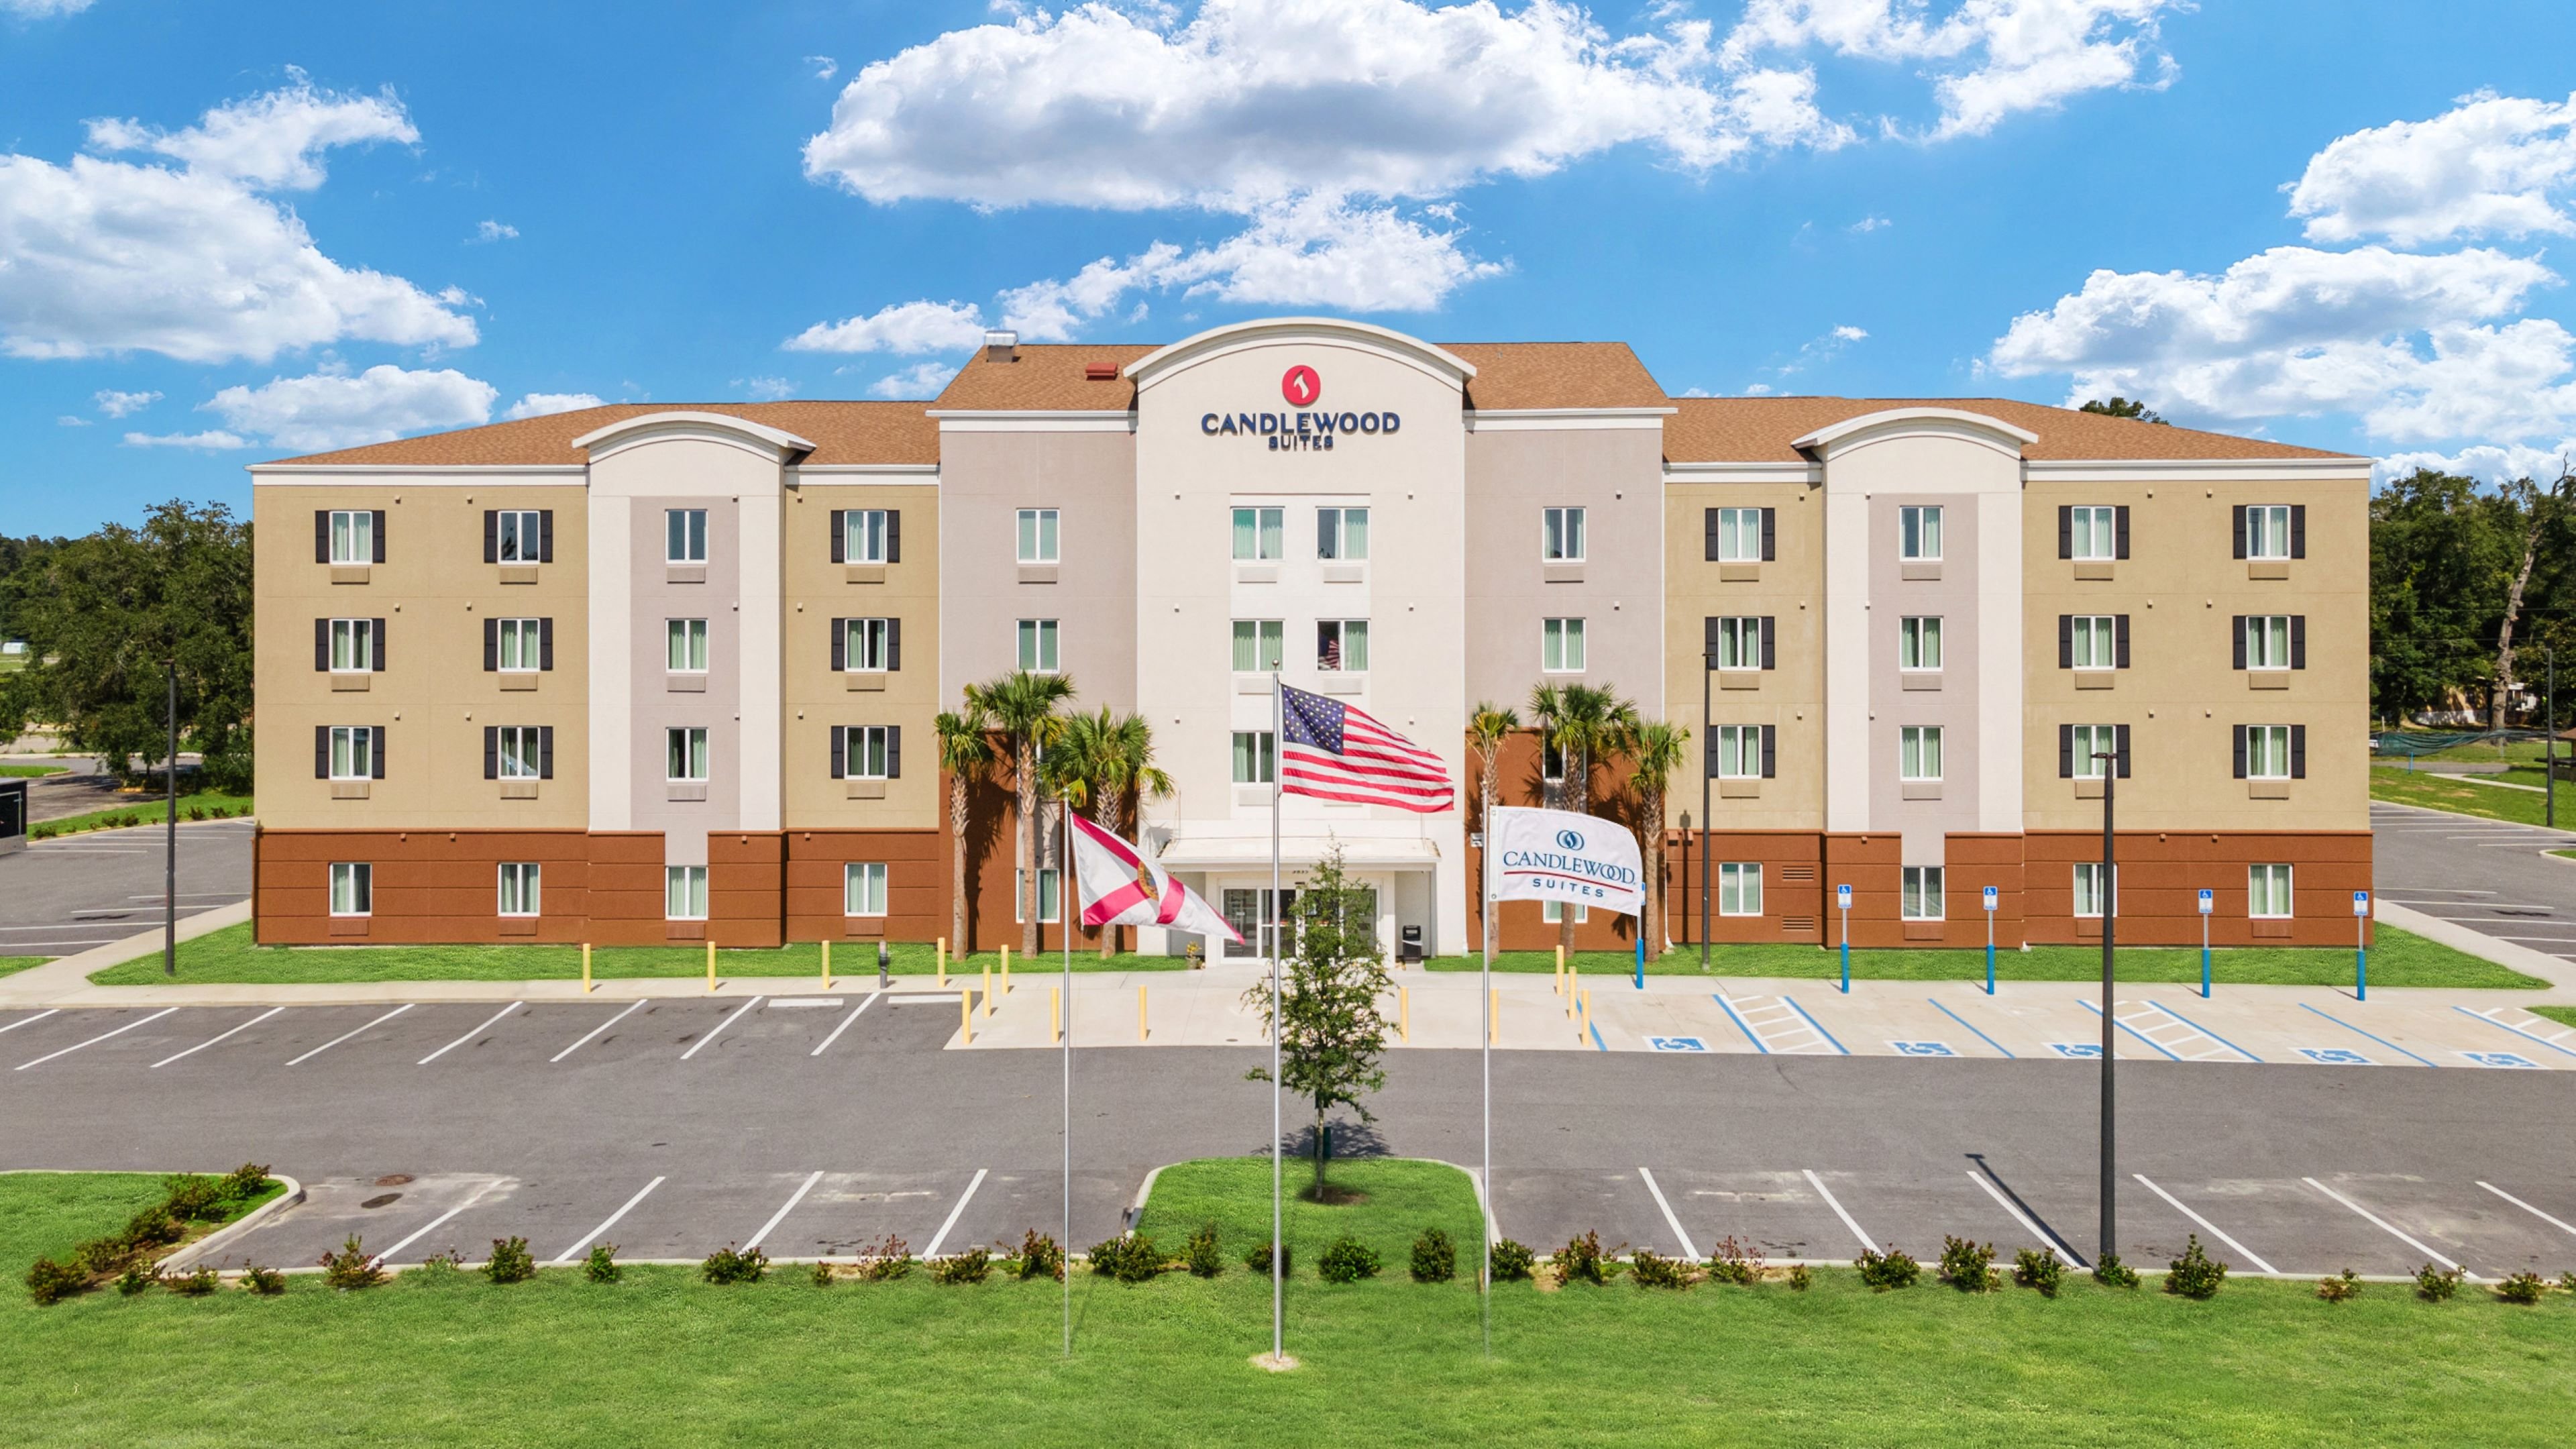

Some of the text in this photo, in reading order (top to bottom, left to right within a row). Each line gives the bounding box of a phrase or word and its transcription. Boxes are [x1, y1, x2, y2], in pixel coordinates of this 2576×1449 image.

[1201, 412, 1401, 435] CANDLEWOOD
[1269, 435, 1334, 451] SUITES
[1503, 851, 1635, 884] CANDLEWOOD
[1532, 878, 1604, 898] SUITES
